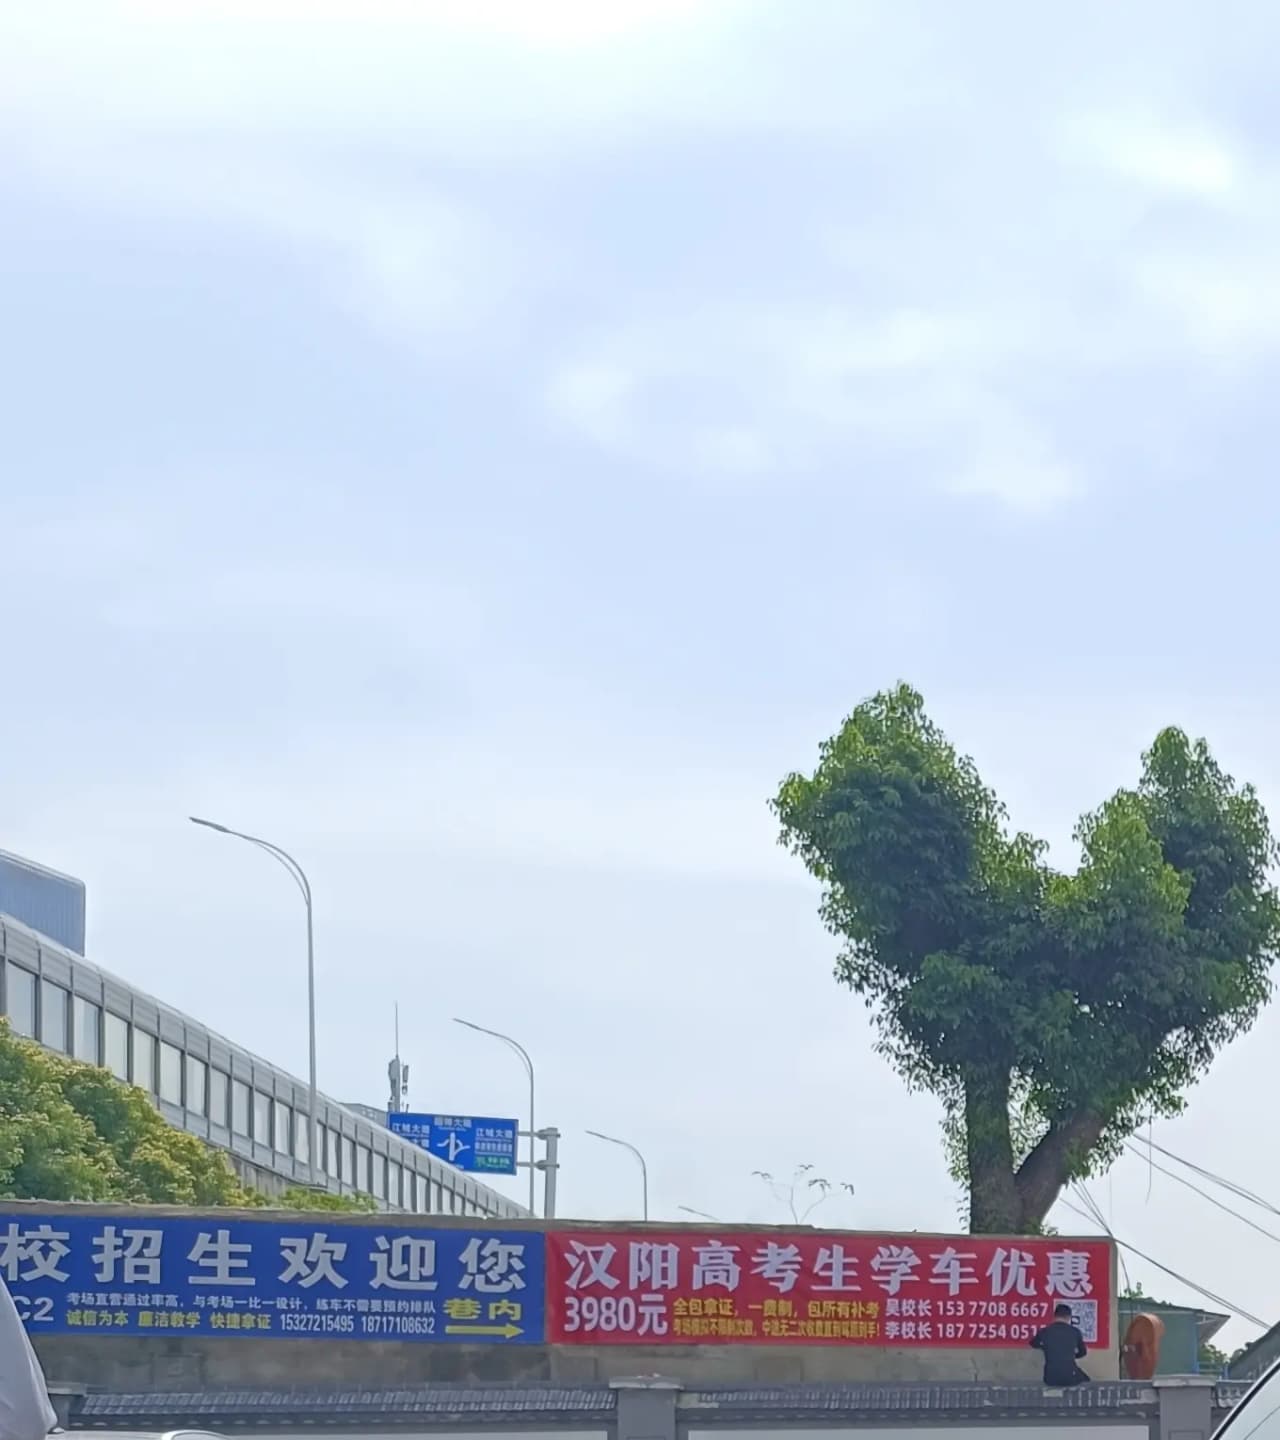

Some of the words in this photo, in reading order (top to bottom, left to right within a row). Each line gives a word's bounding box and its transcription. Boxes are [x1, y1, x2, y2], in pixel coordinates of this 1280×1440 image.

[0, 1223, 526, 1293] 校招生欢迎您
[564, 1239, 1094, 1298] 汉阳高考生学车优惠
[443, 1298, 522, 1321] 巷内
[564, 1293, 668, 1336] 3980元
[885, 1299, 932, 1317] 吴校长
[937, 1301, 965, 1317] 153
[969, 1301, 1007, 1317] 7708
[1010, 1302, 1049, 1318] 6667
[66, 1309, 129, 1327] 诚信为本
[280, 1313, 355, 1333] 15327215495
[361, 1316, 436, 1335] 18717108632
[885, 1322, 932, 1340] 李校长
[937, 1323, 964, 1339] 187
[968, 1323, 1007, 1339] 7254
